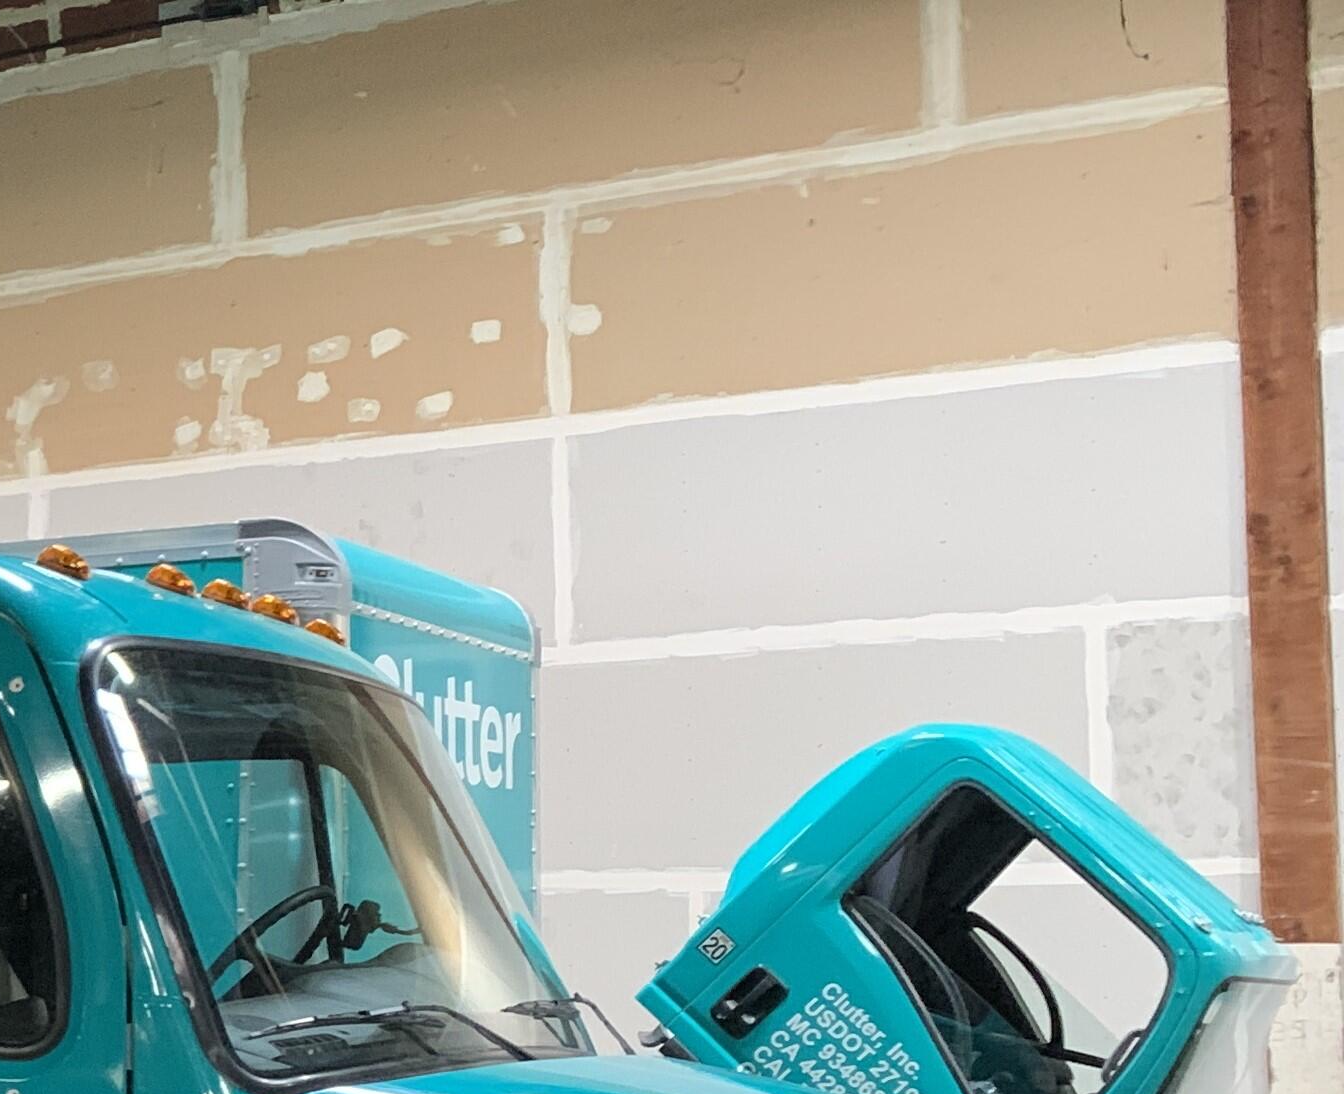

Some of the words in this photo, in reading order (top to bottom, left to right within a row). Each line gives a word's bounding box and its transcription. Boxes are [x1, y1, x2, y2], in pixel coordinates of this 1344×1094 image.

[374, 654, 521, 790] tter
[701, 936, 728, 961] 20
[770, 1030, 800, 1061] CA
[786, 1013, 823, 1046] MC
[804, 998, 876, 1062] USDOT
[822, 982, 887, 1049] Clutter,
[885, 1042, 923, 1081] Inc.
